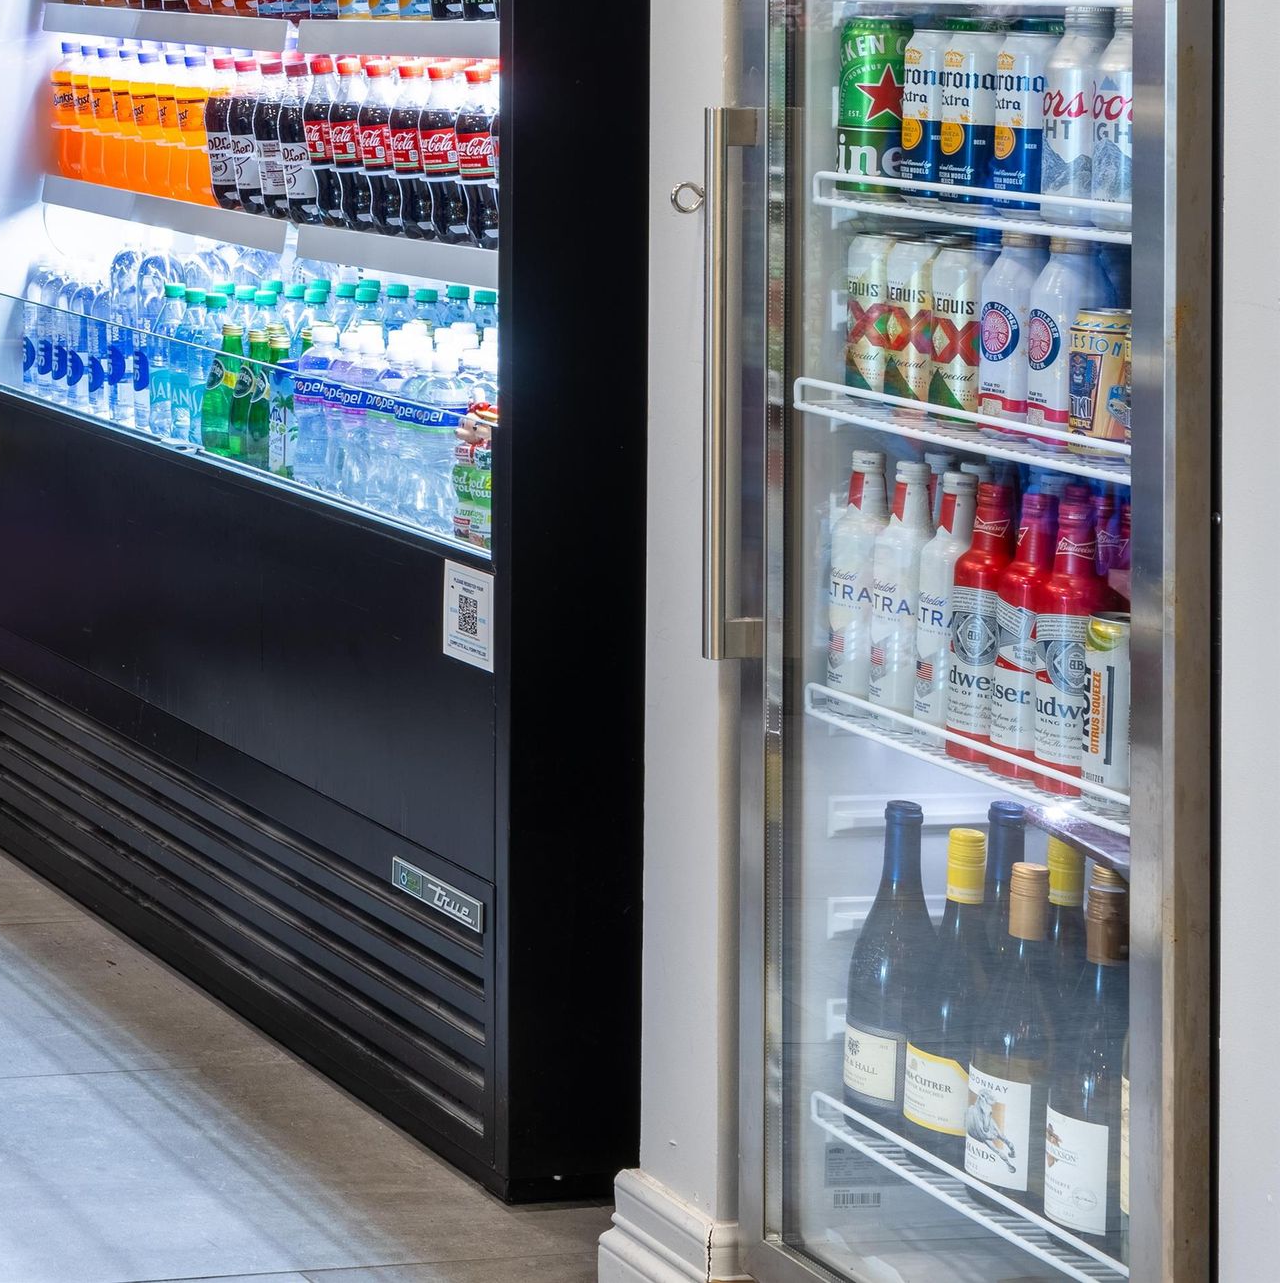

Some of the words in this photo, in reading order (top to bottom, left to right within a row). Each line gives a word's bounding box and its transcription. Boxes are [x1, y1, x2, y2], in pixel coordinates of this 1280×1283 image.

[939, 69, 996, 93] orona
[995, 71, 1046, 94] rona
[53, 92, 73, 106] Sunkis
[903, 91, 928, 105] xtra
[1042, 90, 1088, 118] ors
[456, 137, 492, 156] ca-Cola
[847, 280, 880, 298] EQUIS
[890, 287, 926, 304] EQUIS
[936, 296, 975, 315] EQUIS
[993, 304, 1019, 332] PILSNER
[1036, 310, 1059, 340] PILSNER
[1069, 332, 1123, 358] ESTON
[293, 379, 324, 394] ropel
[365, 395, 395, 410] prope
[413, 409, 444, 423] ropel
[975, 519, 1007, 534] Budweiser
[831, 581, 872, 603] TRA
[873, 593, 911, 616] TRA
[1092, 671, 1102, 715] SQUEEZE
[1040, 718, 1060, 726] KING
[1090, 718, 1100, 755] CITRUS
[427, 883, 473, 924] True
[854, 1061, 878, 1076] HALL
